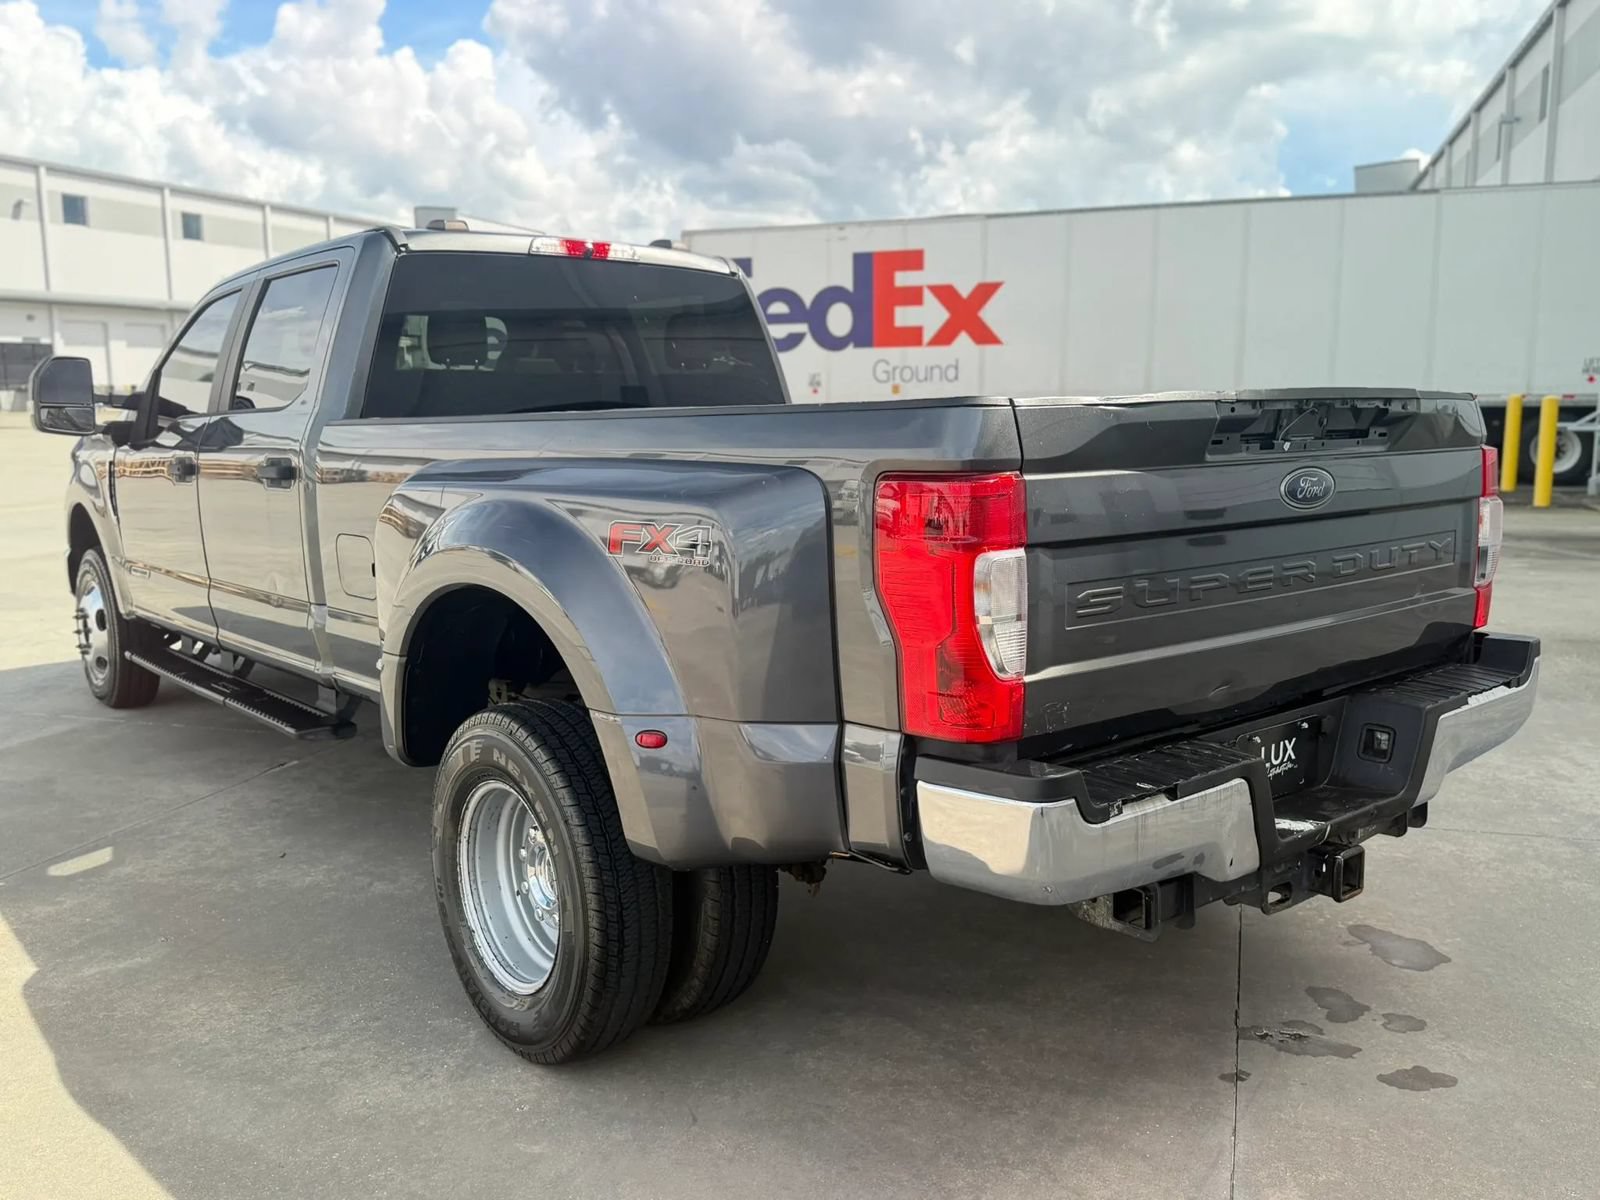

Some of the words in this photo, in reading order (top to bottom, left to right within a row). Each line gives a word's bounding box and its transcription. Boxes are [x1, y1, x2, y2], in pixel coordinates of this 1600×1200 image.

[733, 249, 1004, 352] edEx
[872, 359, 959, 384] Ground
[1296, 476, 1326, 499] Ford
[607, 520, 712, 558] FX4
[1076, 562, 1317, 618] SUPER
[1333, 538, 1452, 578] DUTY
